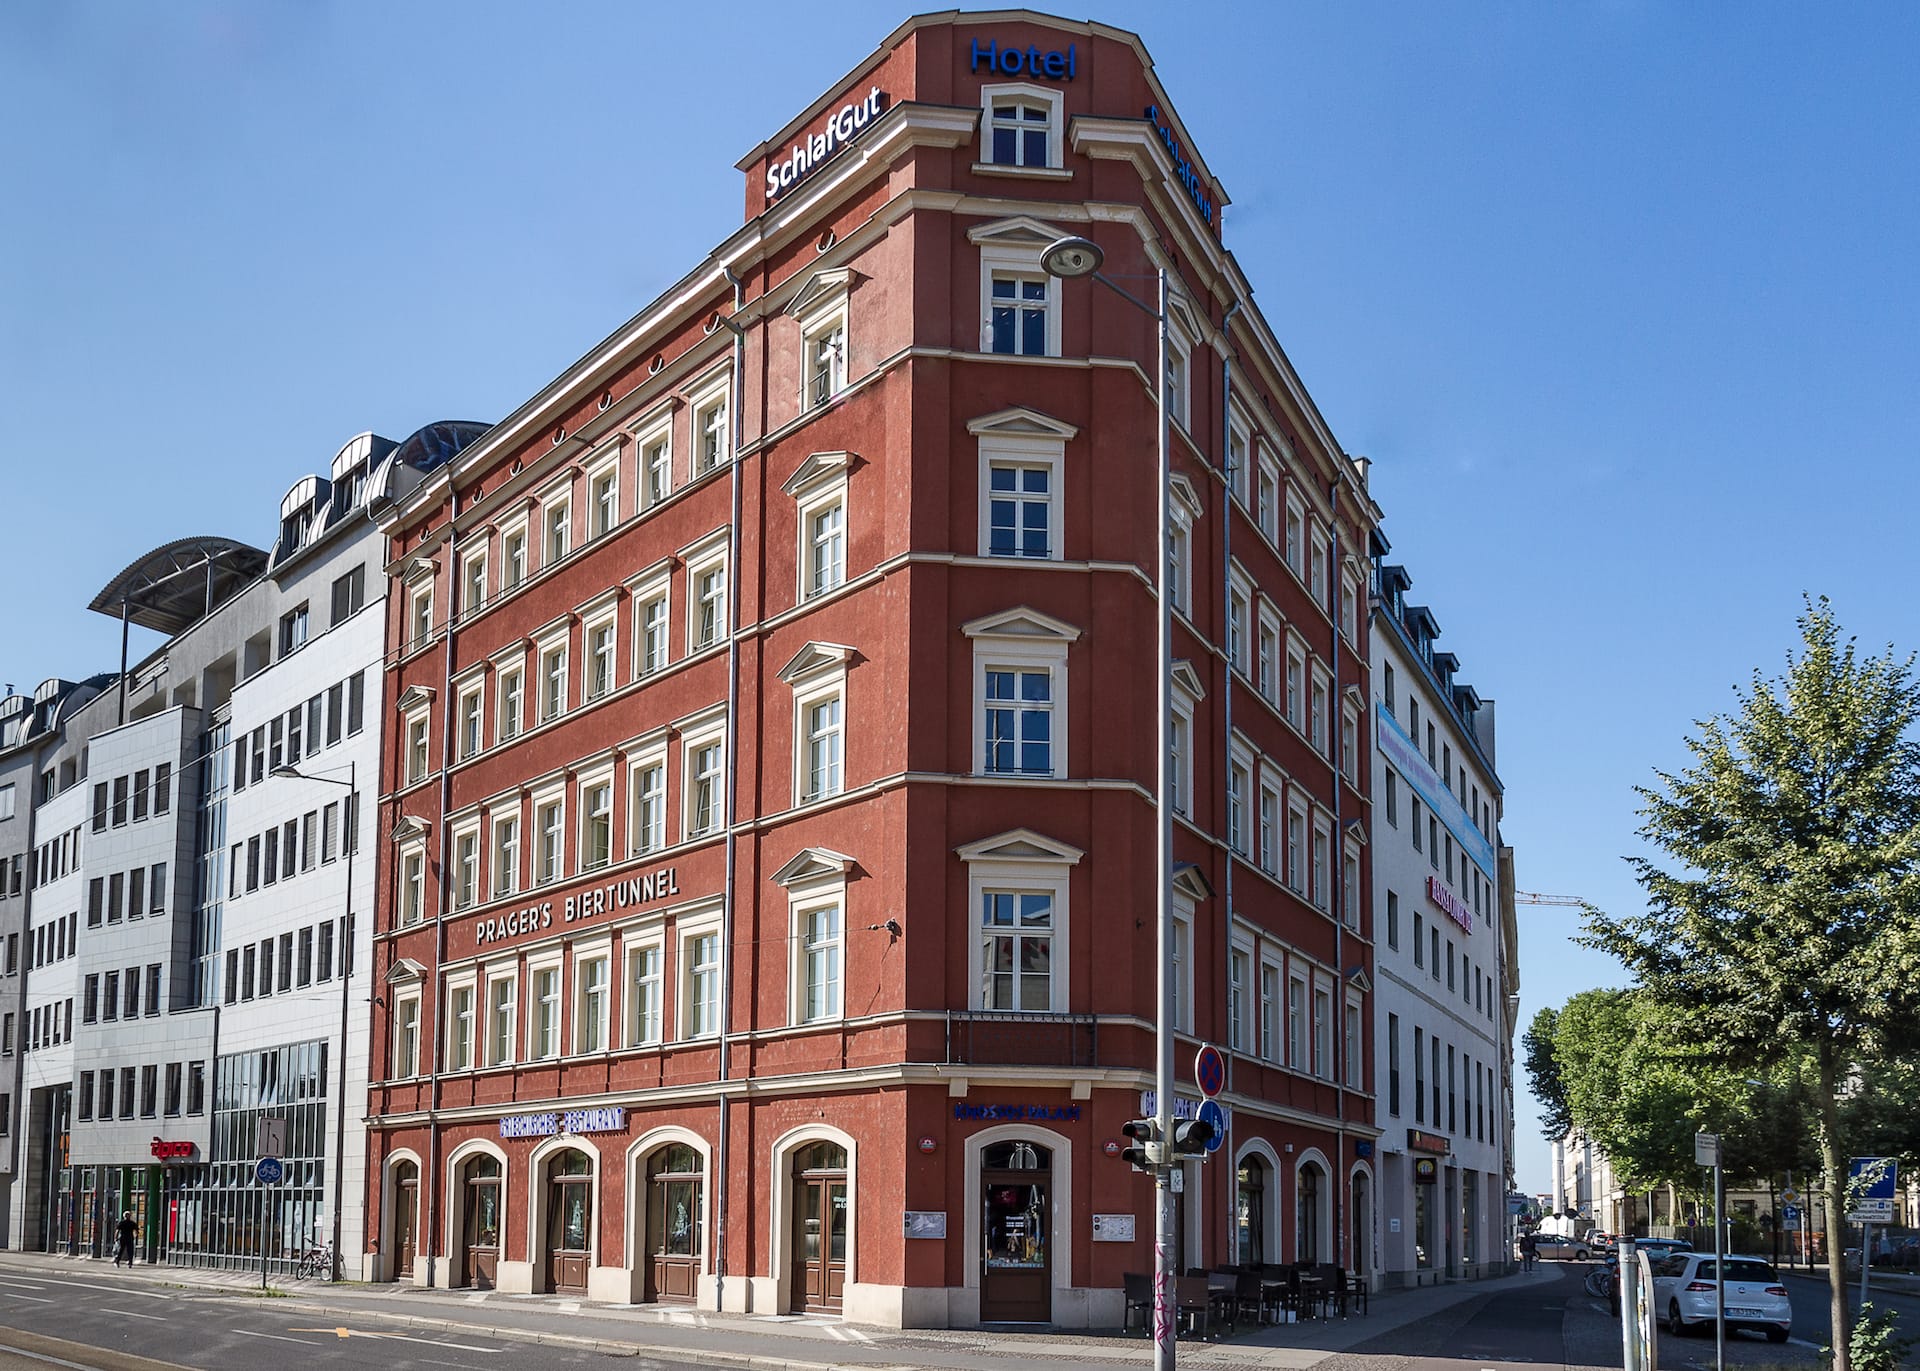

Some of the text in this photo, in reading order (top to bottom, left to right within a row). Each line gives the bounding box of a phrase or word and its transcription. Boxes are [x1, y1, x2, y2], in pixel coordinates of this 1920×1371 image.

[971, 37, 1077, 80] Hotel
[765, 86, 881, 198] SchlafGut
[476, 867, 680, 945] PRAGER'S BIERTUNNEL
[564, 1106, 624, 1133] RESTAURANT
